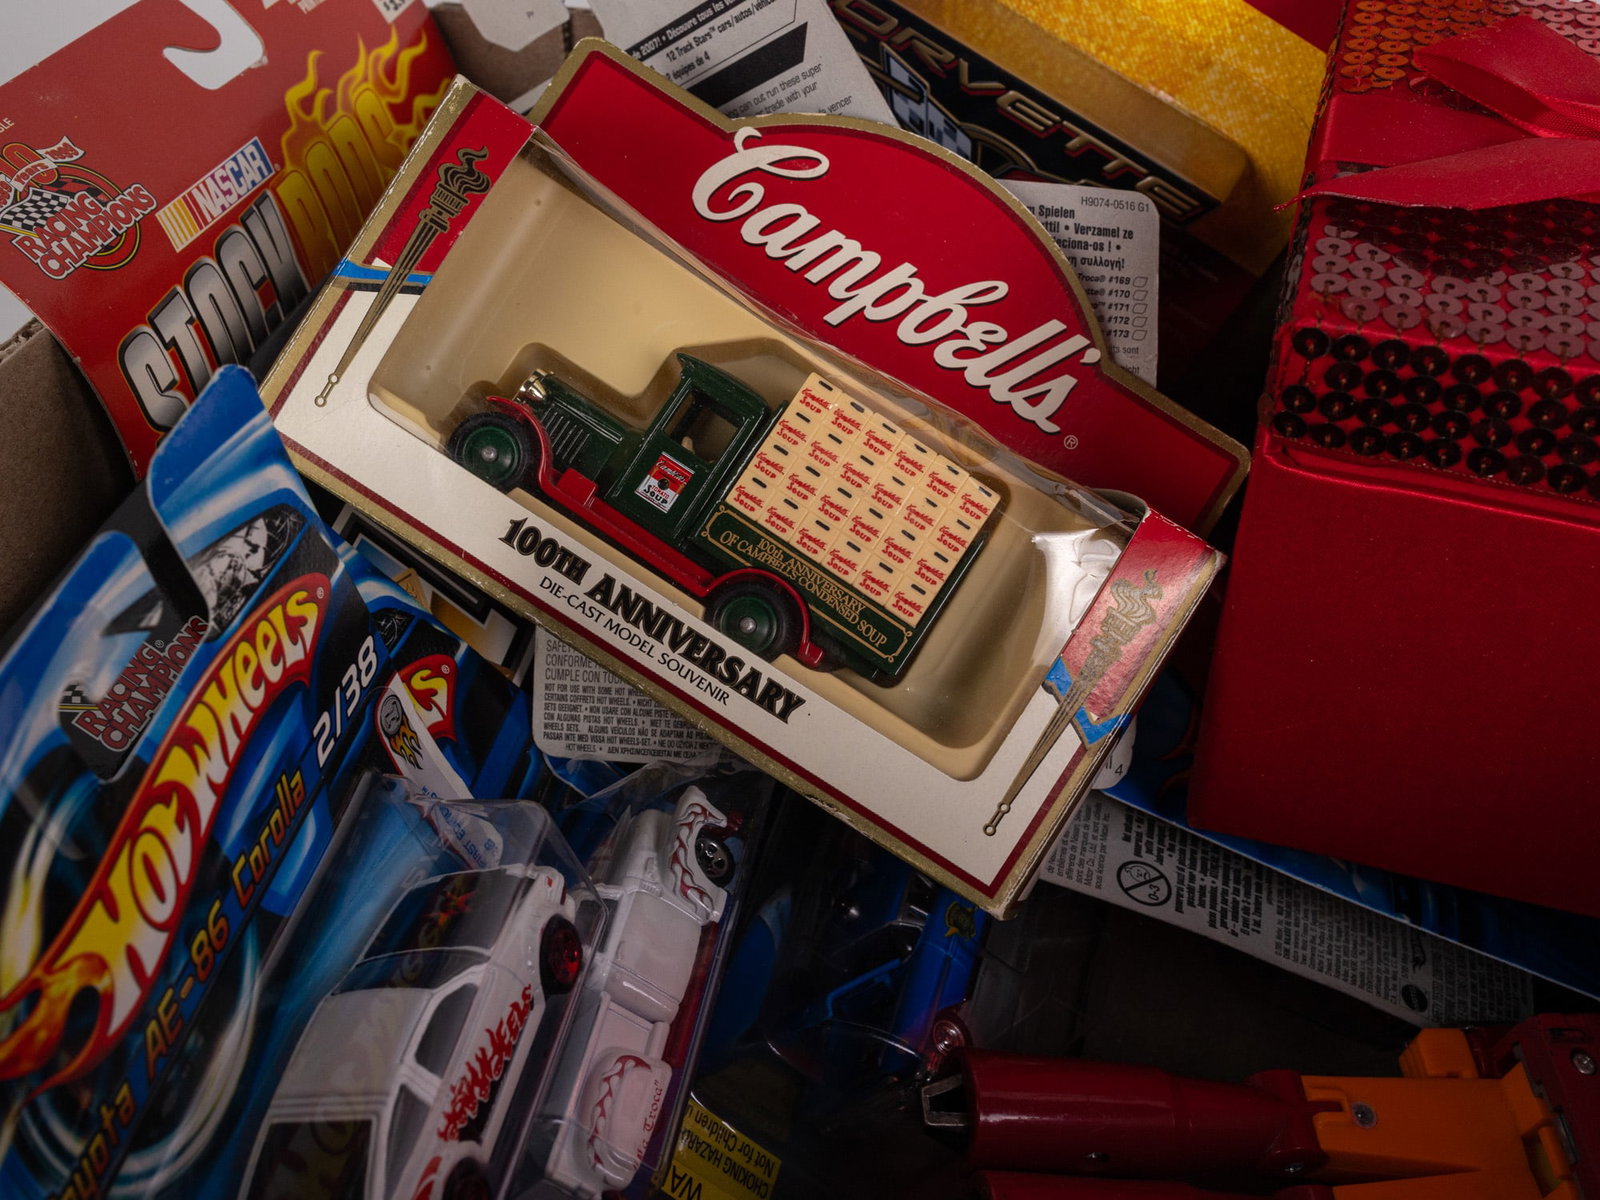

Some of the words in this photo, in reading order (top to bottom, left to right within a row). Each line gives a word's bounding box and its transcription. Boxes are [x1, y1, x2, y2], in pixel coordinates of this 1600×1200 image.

[641, 39, 663, 56] 2007!
[666, 16, 698, 40] Découvre
[698, 7, 713, 23] tous
[666, 50, 676, 62] 12
[676, 42, 694, 57] Track
[672, 61, 696, 83] équipes
[696, 55, 704, 66] de
[704, 51, 711, 62] 4
[740, 101, 753, 114] can
[766, 86, 780, 101] run
[779, 75, 801, 93] these
[801, 63, 822, 80] super
[764, 99, 785, 114] trade
[785, 90, 801, 105] with
[800, 81, 818, 99] your
[827, 95, 853, 114] vencer
[835, 0, 1200, 216] ORVETTE
[194, 146, 273, 226] NASCAR
[1038, 204, 1076, 220] Spielen
[1080, 196, 1136, 212] H9074-0516
[1137, 202, 1150, 214] G1
[14, 191, 104, 262] RACING
[38, 184, 157, 279] CHAMPIONS
[1073, 222, 1120, 239] Verzamel
[1122, 228, 1134, 240] ze
[691, 125, 1102, 434] Campbell's
[1107, 275, 1131, 286] #169
[1107, 288, 1131, 299] #170
[118, 189, 311, 431] STOCK
[1107, 302, 1130, 312] #171
[1107, 315, 1130, 326] #172
[1106, 328, 1130, 339] #173
[1122, 345, 1140, 355] sont
[719, 530, 738, 546] OF
[797, 576, 860, 625] CONDENSED
[857, 618, 888, 648] SOUP
[757, 537, 785, 561] 100th
[785, 556, 867, 616] ANNIVERSARY
[498, 516, 593, 586] 100TH
[583, 572, 807, 725] ANNIVERSARY
[538, 575, 606, 626] DIE-CAST
[603, 617, 656, 659] MODEL
[657, 652, 731, 707] SOUVENIR
[545, 653, 592, 669] CONFORME
[545, 667, 580, 682] CUMPLE
[582, 670, 600, 683] CON
[72, 642, 159, 742] RACING
[101, 615, 210, 752] CHAMPIONS
[544, 683, 555, 692] NOT
[557, 684, 568, 693] FOR
[569, 684, 580, 693] USE
[582, 685, 596, 694] WITH
[597, 686, 613, 695] SOME
[614, 687, 626, 696] HOT
[312, 634, 379, 769] 2/38
[597, 696, 607, 704] HOT
[1114, 763, 1123, 776] 4
[1148, 883, 1161, 901] 0-3
[50, 1082, 137, 1200] yota
[145, 899, 231, 1080] AE-86
[232, 769, 306, 908] Corolla
[695, 1110, 738, 1154] Children
[738, 1139, 755, 1164] for
[757, 1151, 776, 1179] Not
[722, 1157, 770, 1200] CHOKING
